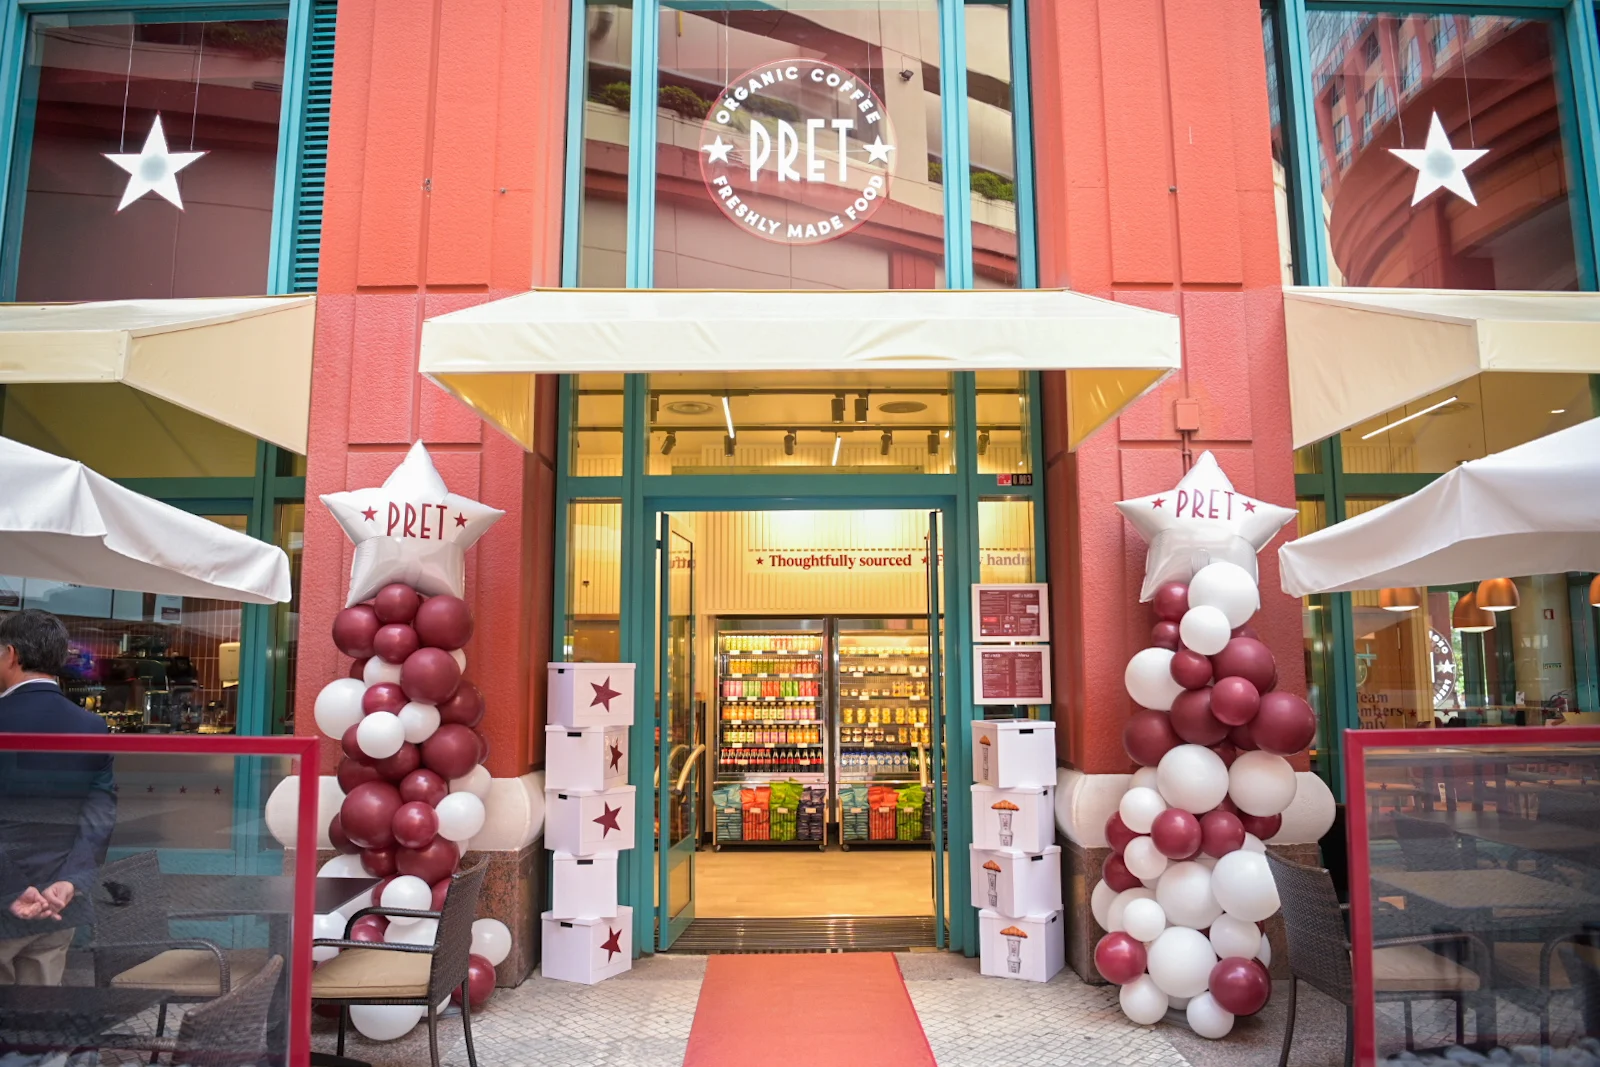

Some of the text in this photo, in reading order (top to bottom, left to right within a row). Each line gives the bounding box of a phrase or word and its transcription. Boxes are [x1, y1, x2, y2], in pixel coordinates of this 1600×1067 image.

[716, 66, 881, 124] ORGANIC COFFEE
[749, 118, 854, 182] PRET
[713, 175, 884, 238] FRESHLY MADE FOOD
[387, 501, 448, 540] PRET
[1176, 488, 1234, 520] PRET
[769, 554, 856, 570] Thoughtfully
[859, 554, 912, 567] sourced
[1359, 705, 1403, 717] mbers
